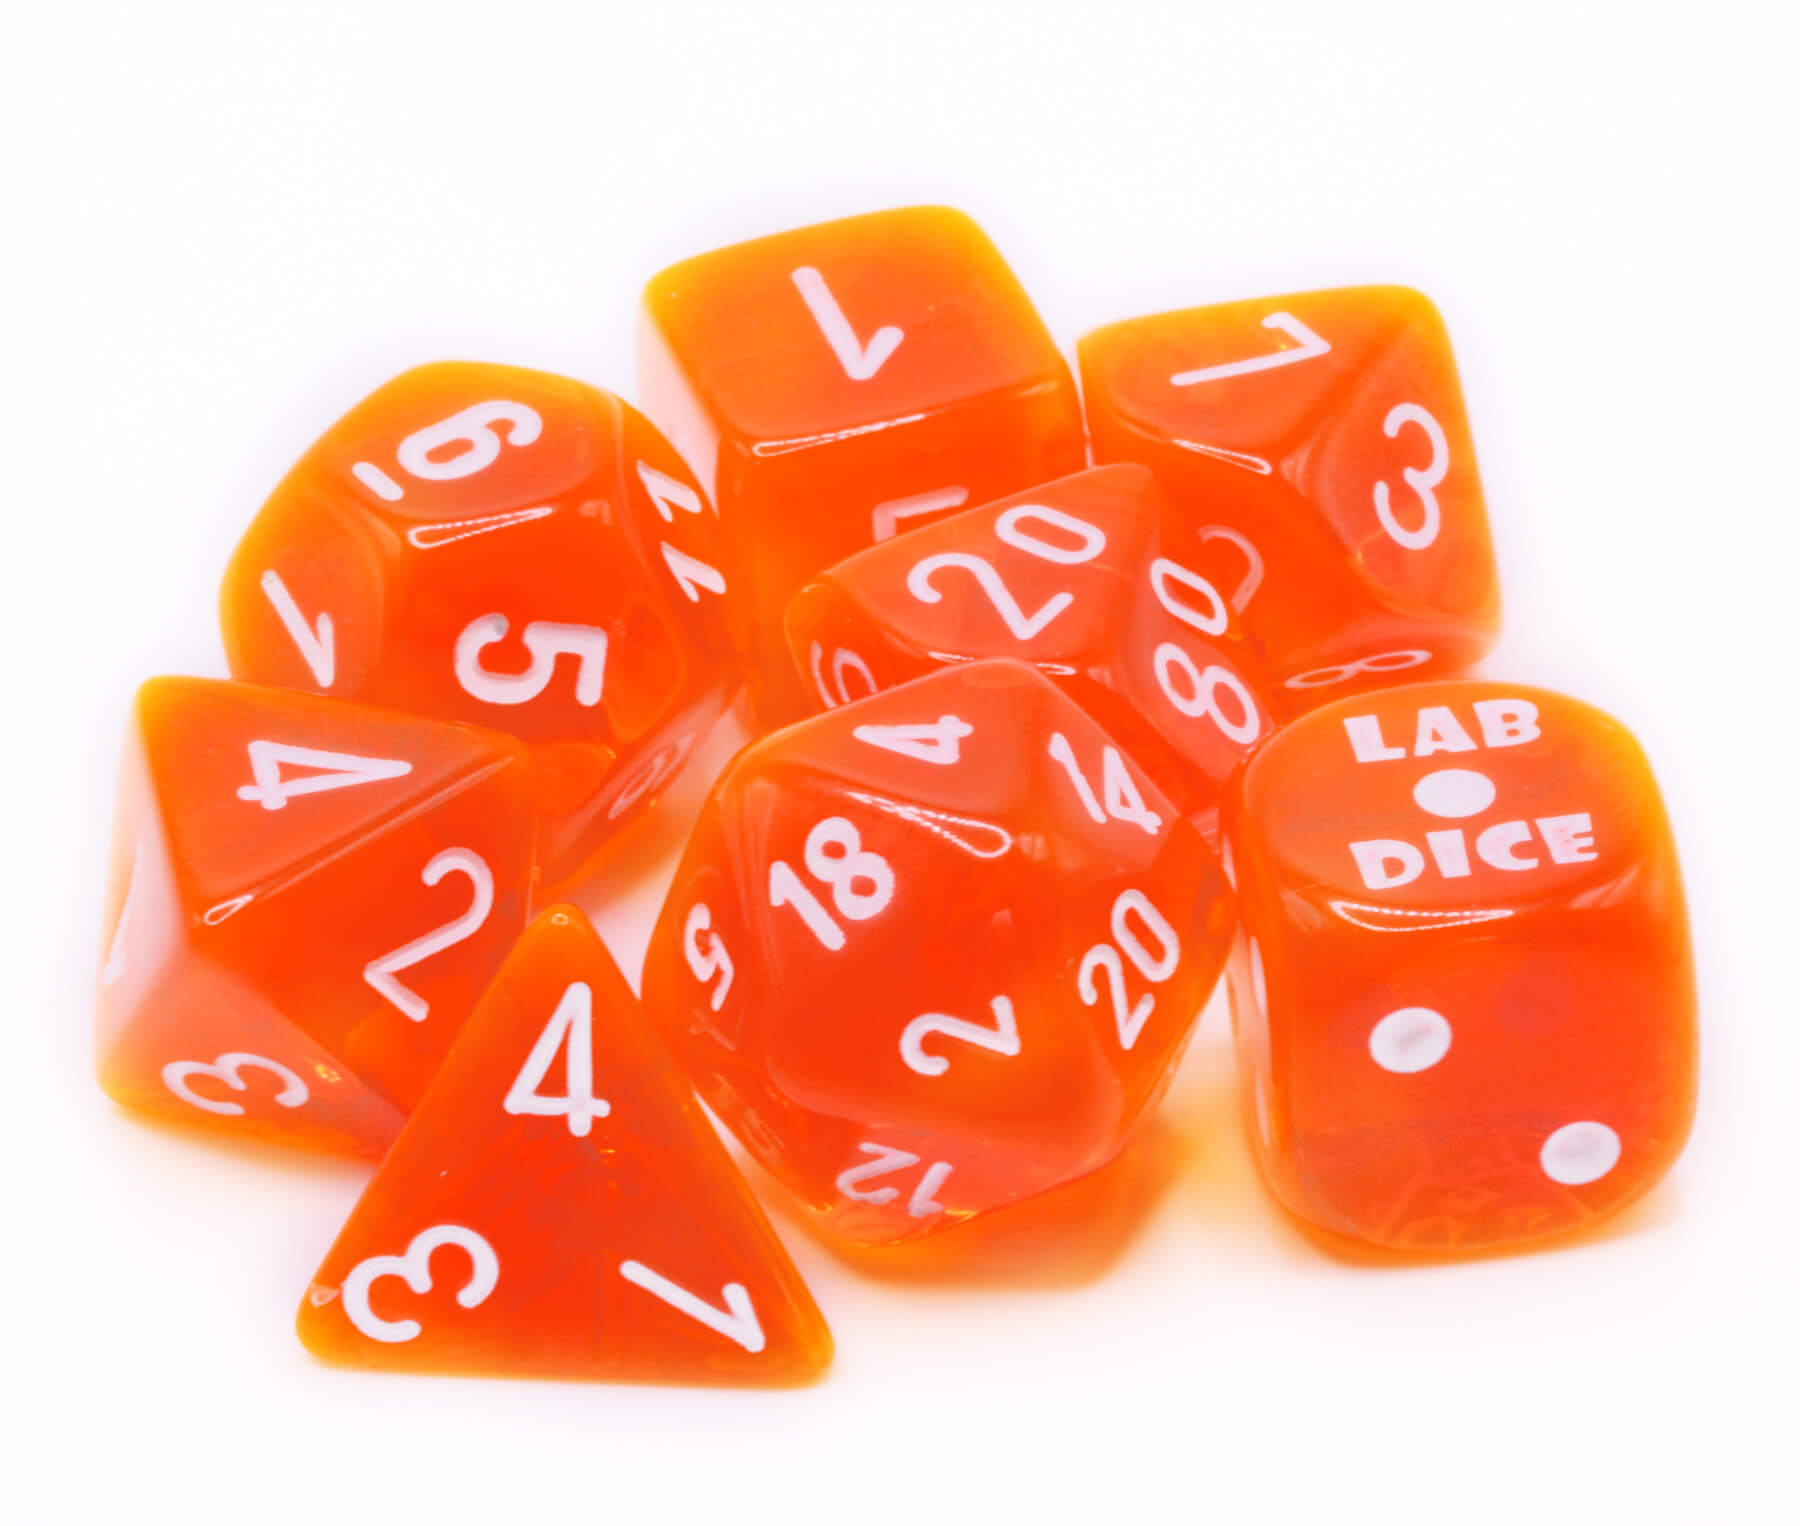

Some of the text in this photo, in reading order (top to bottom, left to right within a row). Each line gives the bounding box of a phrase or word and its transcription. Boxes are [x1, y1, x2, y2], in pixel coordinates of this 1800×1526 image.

[791, 266, 905, 381] 1
[352, 399, 543, 502] 6
[1373, 402, 1450, 551] 3
[636, 459, 727, 603] 11
[906, 503, 1107, 641] 20
[260, 569, 335, 688] 1
[454, 615, 608, 707] 5
[1284, 649, 1433, 690] 8
[236, 739, 413, 811] 4
[853, 714, 974, 765] 4
[1343, 698, 1542, 764] LAB
[1047, 732, 1163, 836] 14
[768, 816, 896, 952] 18
[1348, 812, 1599, 891] DICE
[362, 846, 495, 1022] 2
[683, 902, 735, 1012] 5
[1076, 888, 1181, 1051] 20
[161, 1051, 309, 1116] 3
[503, 981, 611, 1138] 4
[898, 994, 1021, 1077] 2
[835, 1141, 954, 1218] 12
[341, 1223, 500, 1344] 3
[618, 1259, 767, 1354] 1
